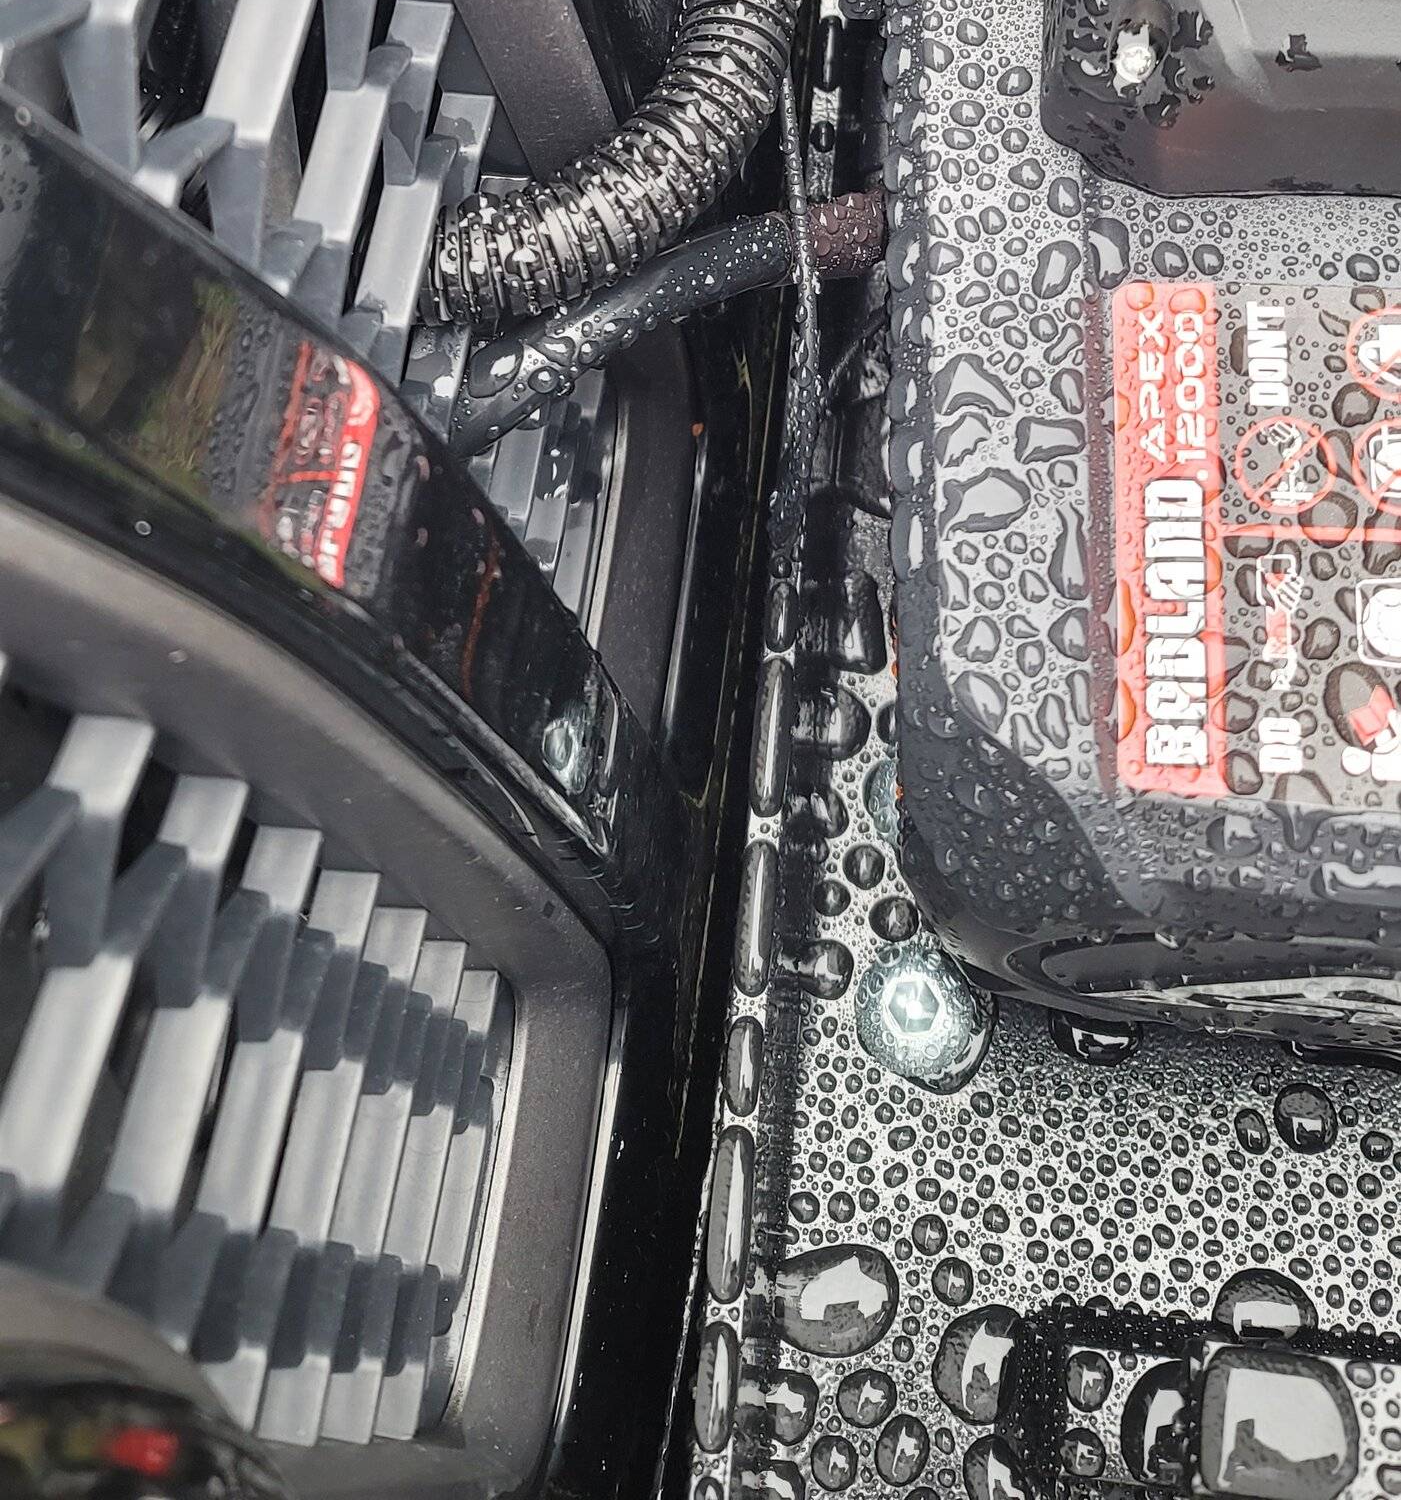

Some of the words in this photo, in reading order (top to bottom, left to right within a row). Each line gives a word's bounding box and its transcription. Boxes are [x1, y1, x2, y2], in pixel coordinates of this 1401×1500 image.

[1139, 311, 1167, 463] APEX
[1173, 311, 1207, 465] 12000
[1257, 716, 1303, 775] DO
